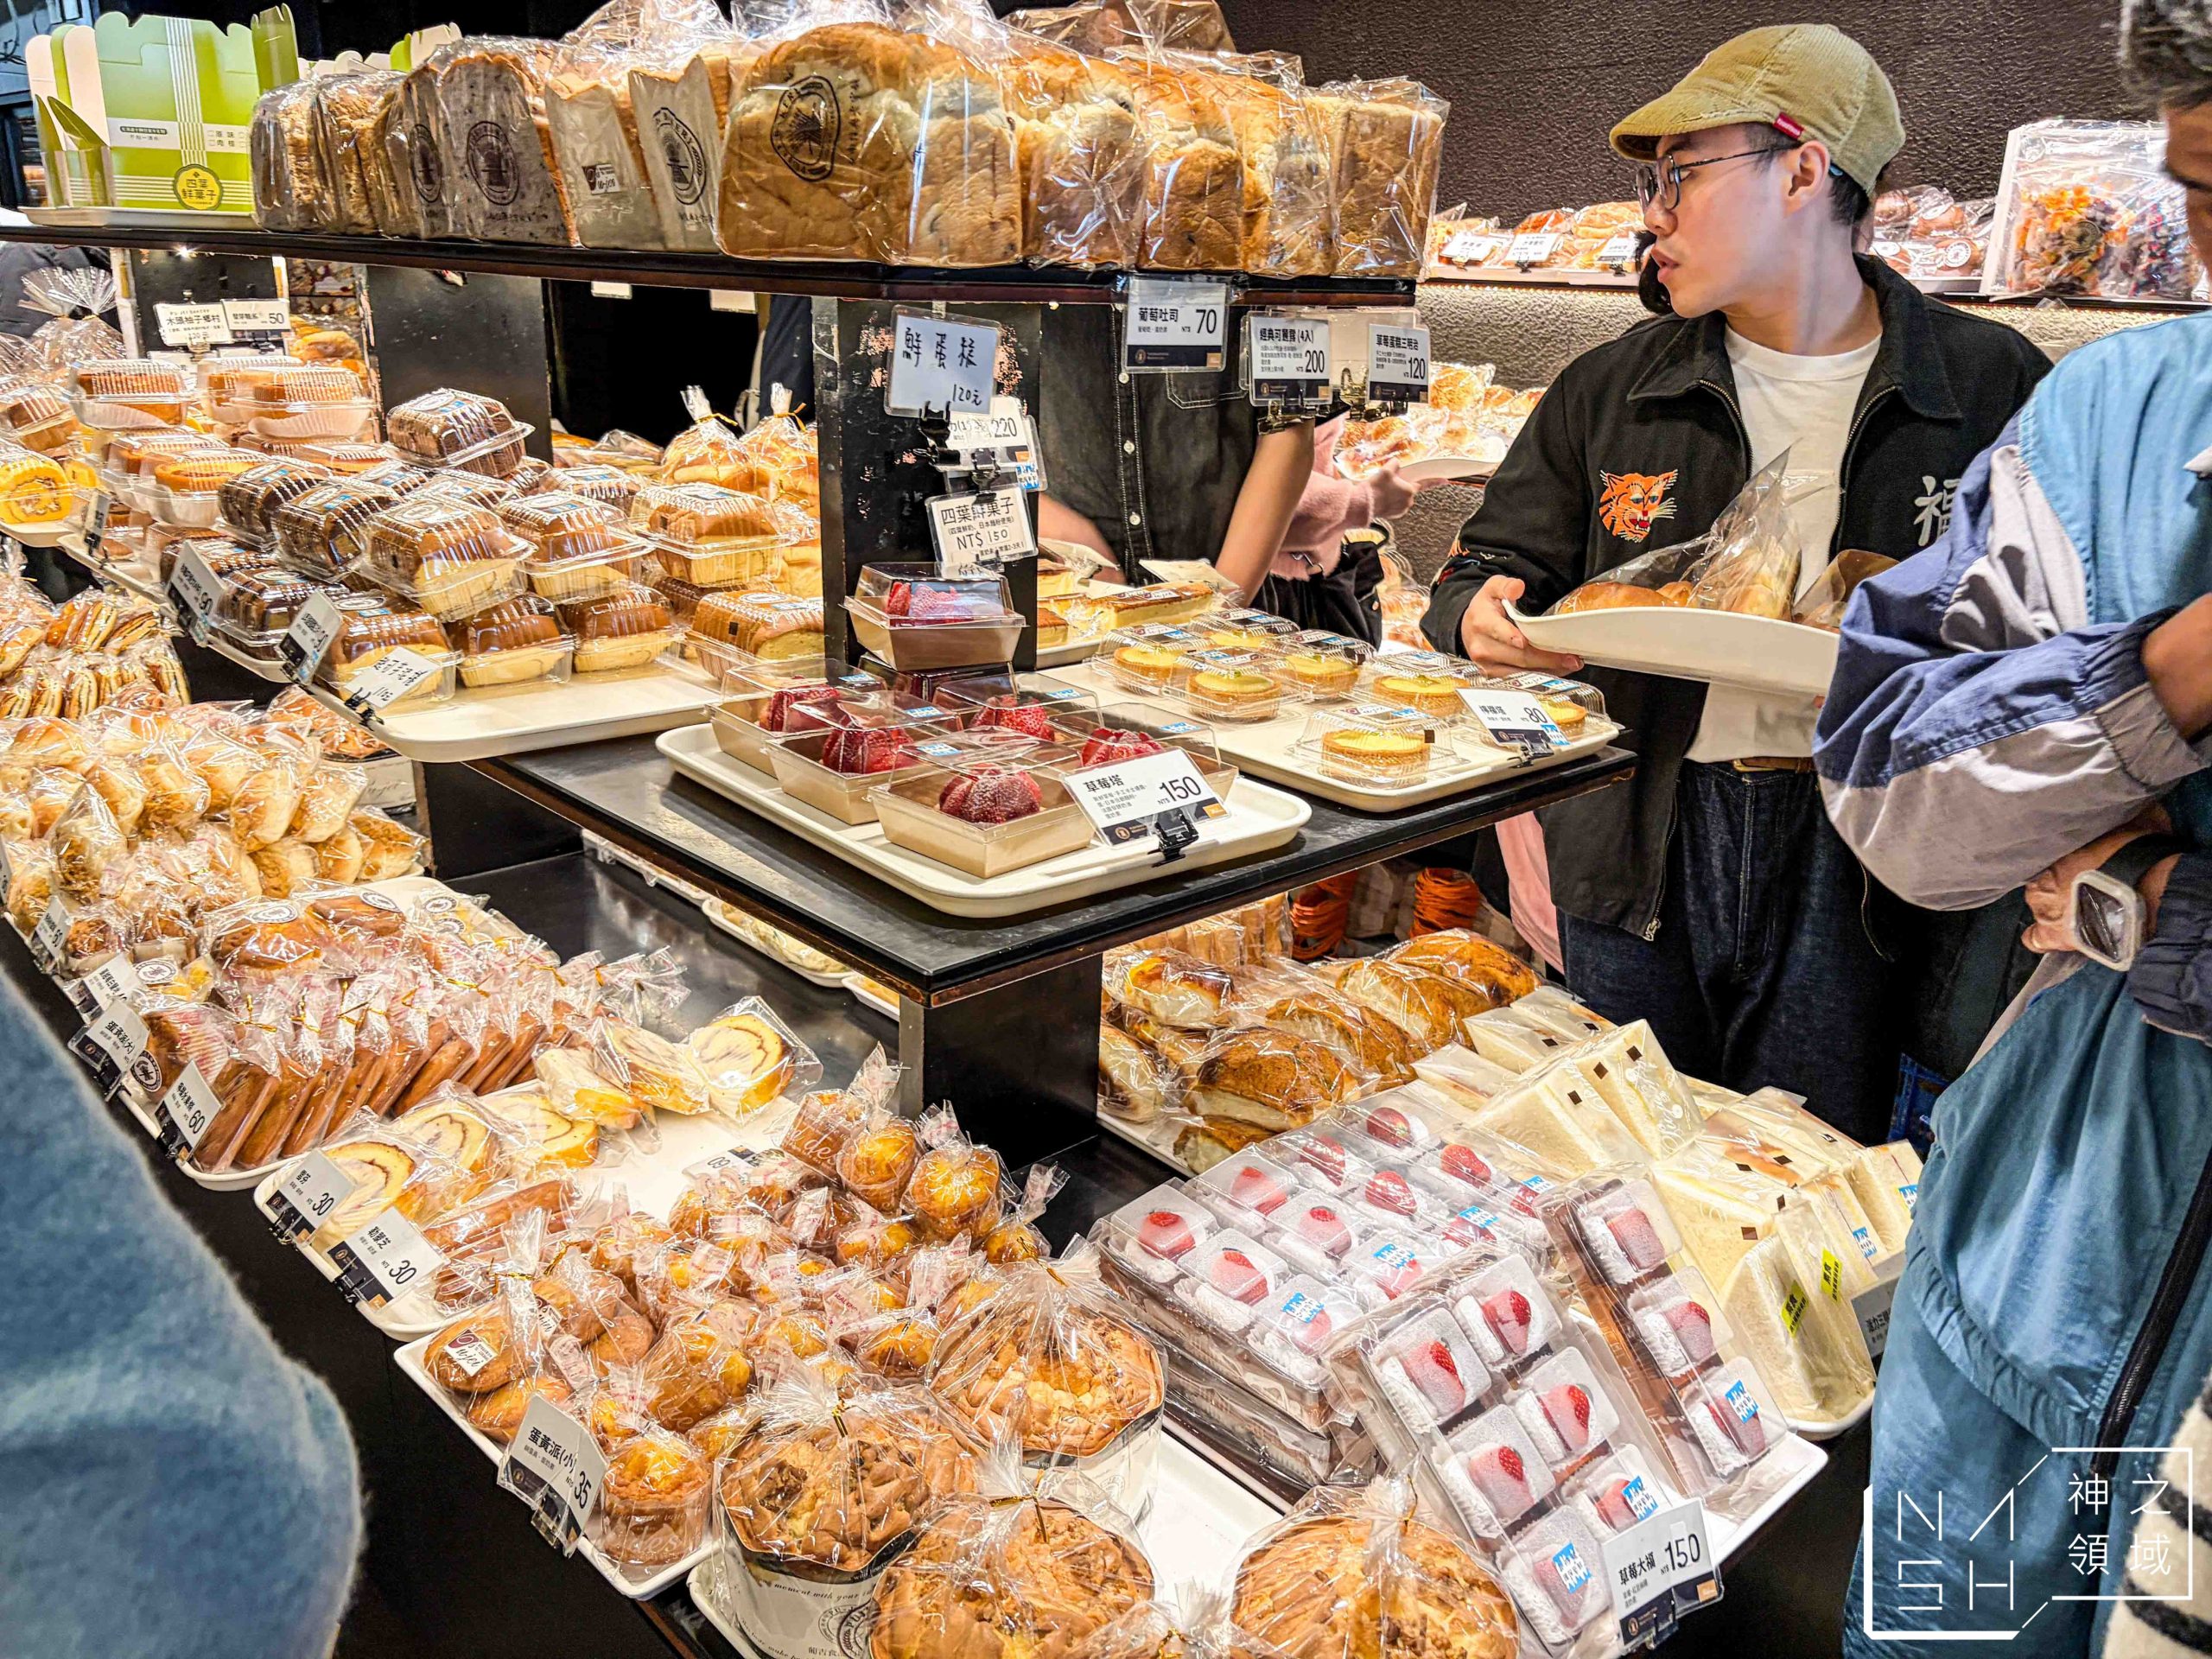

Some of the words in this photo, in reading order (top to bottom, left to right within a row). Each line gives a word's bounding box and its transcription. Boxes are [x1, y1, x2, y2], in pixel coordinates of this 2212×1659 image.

[269, 312, 285, 324] 50
[1139, 307, 1179, 322] 葡萄吐司
[1196, 308, 1217, 334] 70
[1305, 350, 1325, 373] 200
[1408, 357, 1426, 380] 120
[952, 384, 983, 407] 120元
[957, 531, 984, 550] NT$
[988, 528, 1008, 543] 150
[1523, 707, 1548, 724] 80
[1083, 774, 1125, 793] 草莓塔
[1159, 776, 1202, 802] 150
[188, 1109, 206, 1135] 60
[312, 1192, 335, 1216] 30
[389, 1260, 417, 1285] 30
[528, 1426, 577, 1474] 蛋黃派(小)
[574, 1471, 592, 1510] 35
[1664, 1533, 1701, 1572] 150
[1618, 1551, 1656, 1586] 草莓大福
